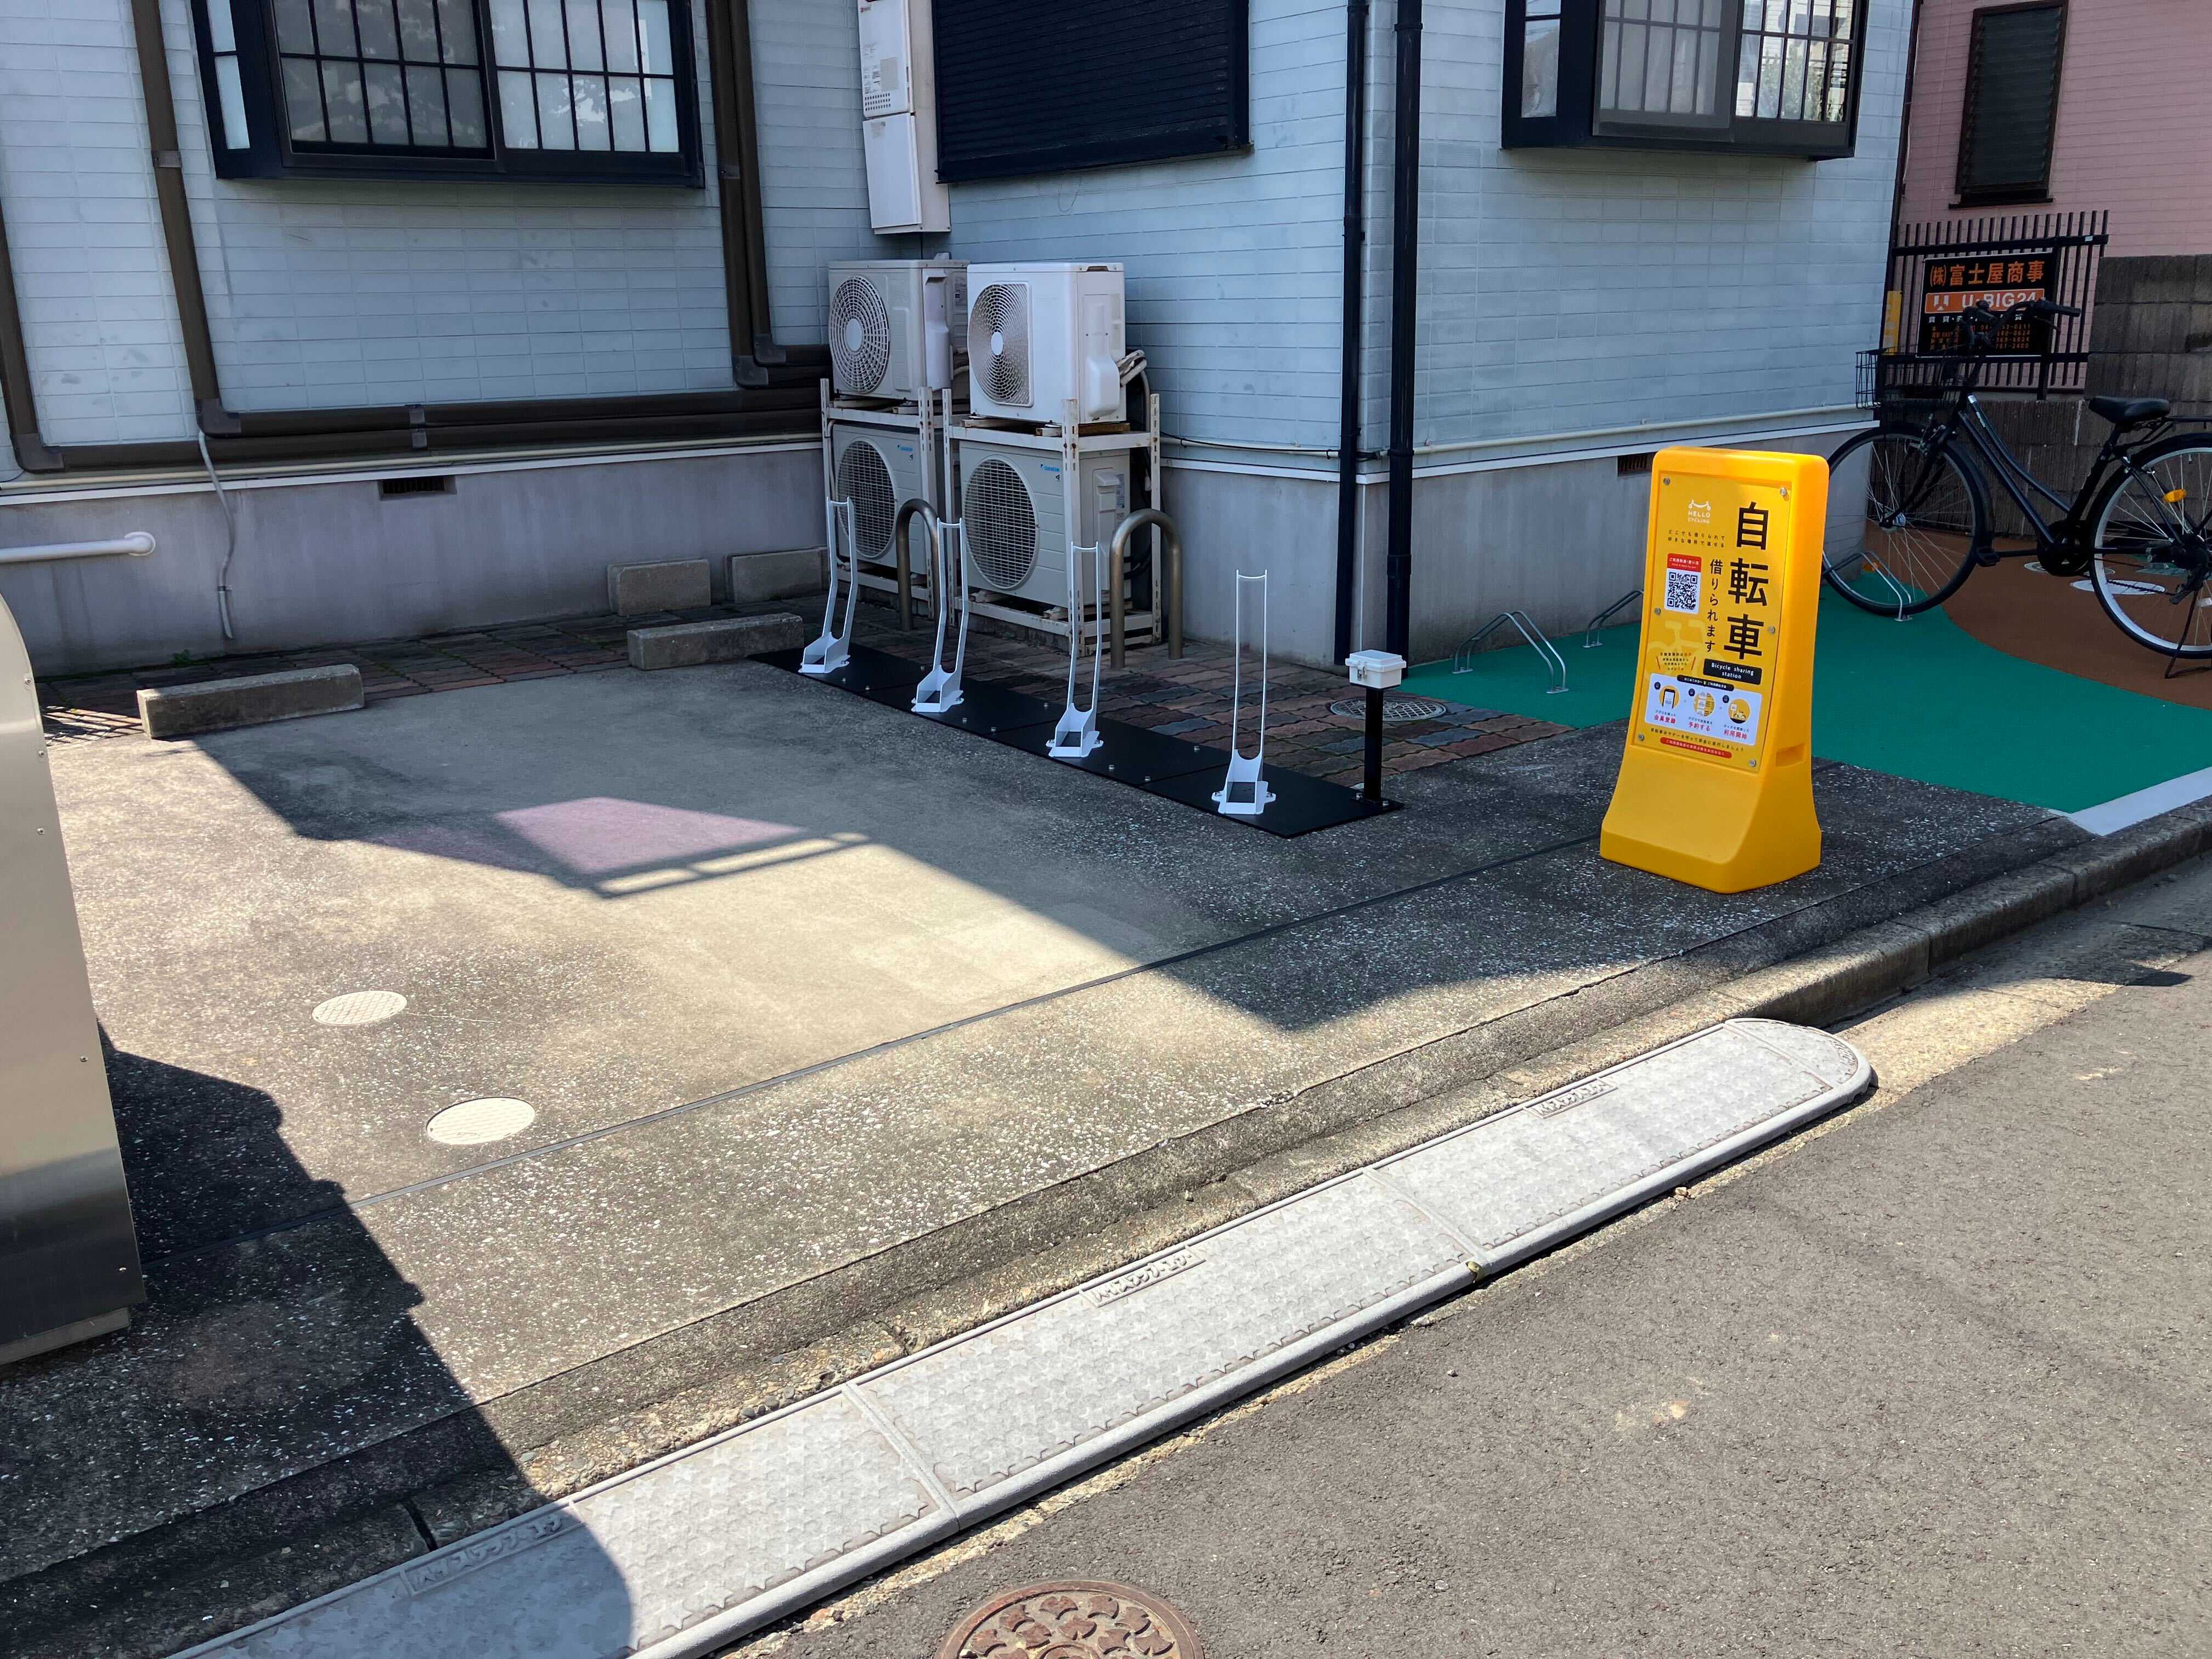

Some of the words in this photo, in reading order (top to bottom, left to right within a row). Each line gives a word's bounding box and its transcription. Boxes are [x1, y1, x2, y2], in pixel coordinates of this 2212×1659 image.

[1688, 510, 1711, 518] HELLO
[1724, 501, 1769, 660] 自転車
[1705, 558, 1723, 652] 借りられます
[1711, 662, 1731, 671] Bicycle
[1734, 667, 1754, 676] sharing
[1654, 714, 1677, 724] 会員登録
[1688, 721, 1711, 732] 予約する
[1723, 729, 1748, 740] 利用開始
